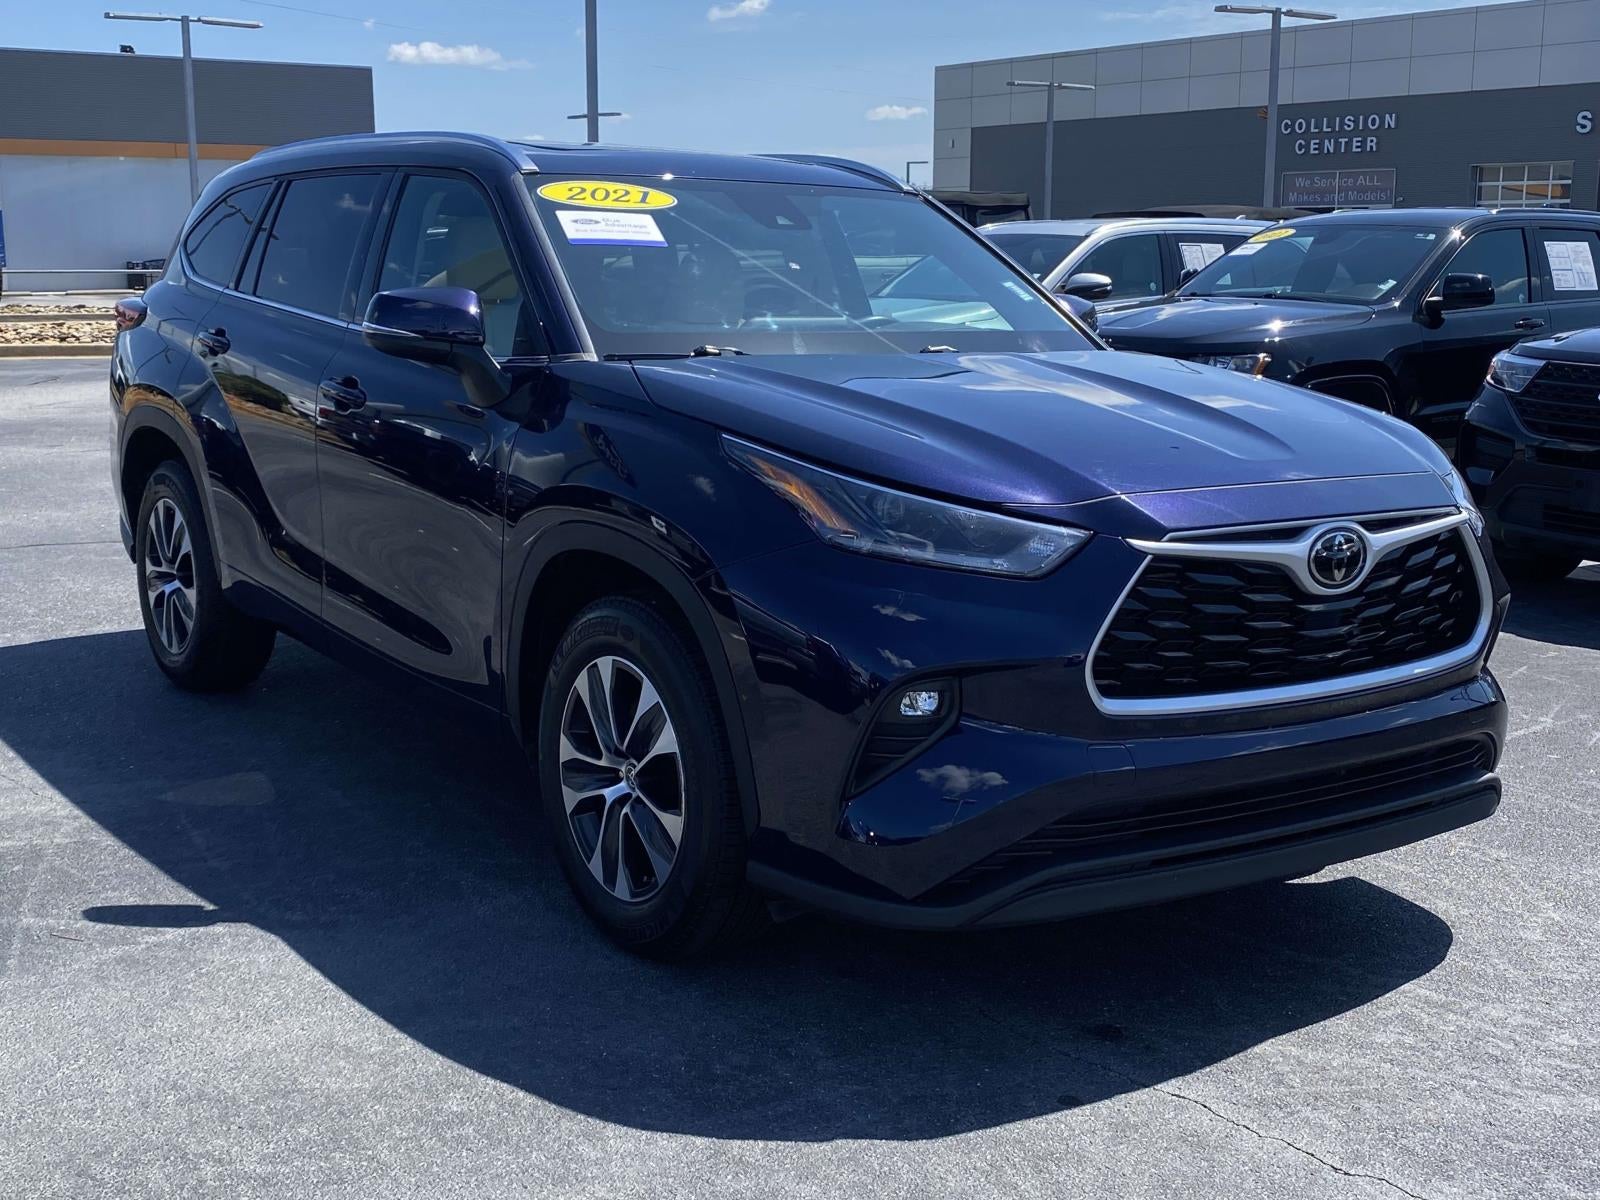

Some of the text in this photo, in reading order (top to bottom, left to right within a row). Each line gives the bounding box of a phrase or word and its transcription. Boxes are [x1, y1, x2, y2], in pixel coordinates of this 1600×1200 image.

[1281, 113, 1396, 134] COLLISION
[1576, 111, 1592, 133] S
[1295, 136, 1377, 154] CENTER
[1295, 175, 1382, 188] We Service ALL
[566, 186, 650, 204] 2021
[1288, 190, 1391, 203] Makes and Models!
